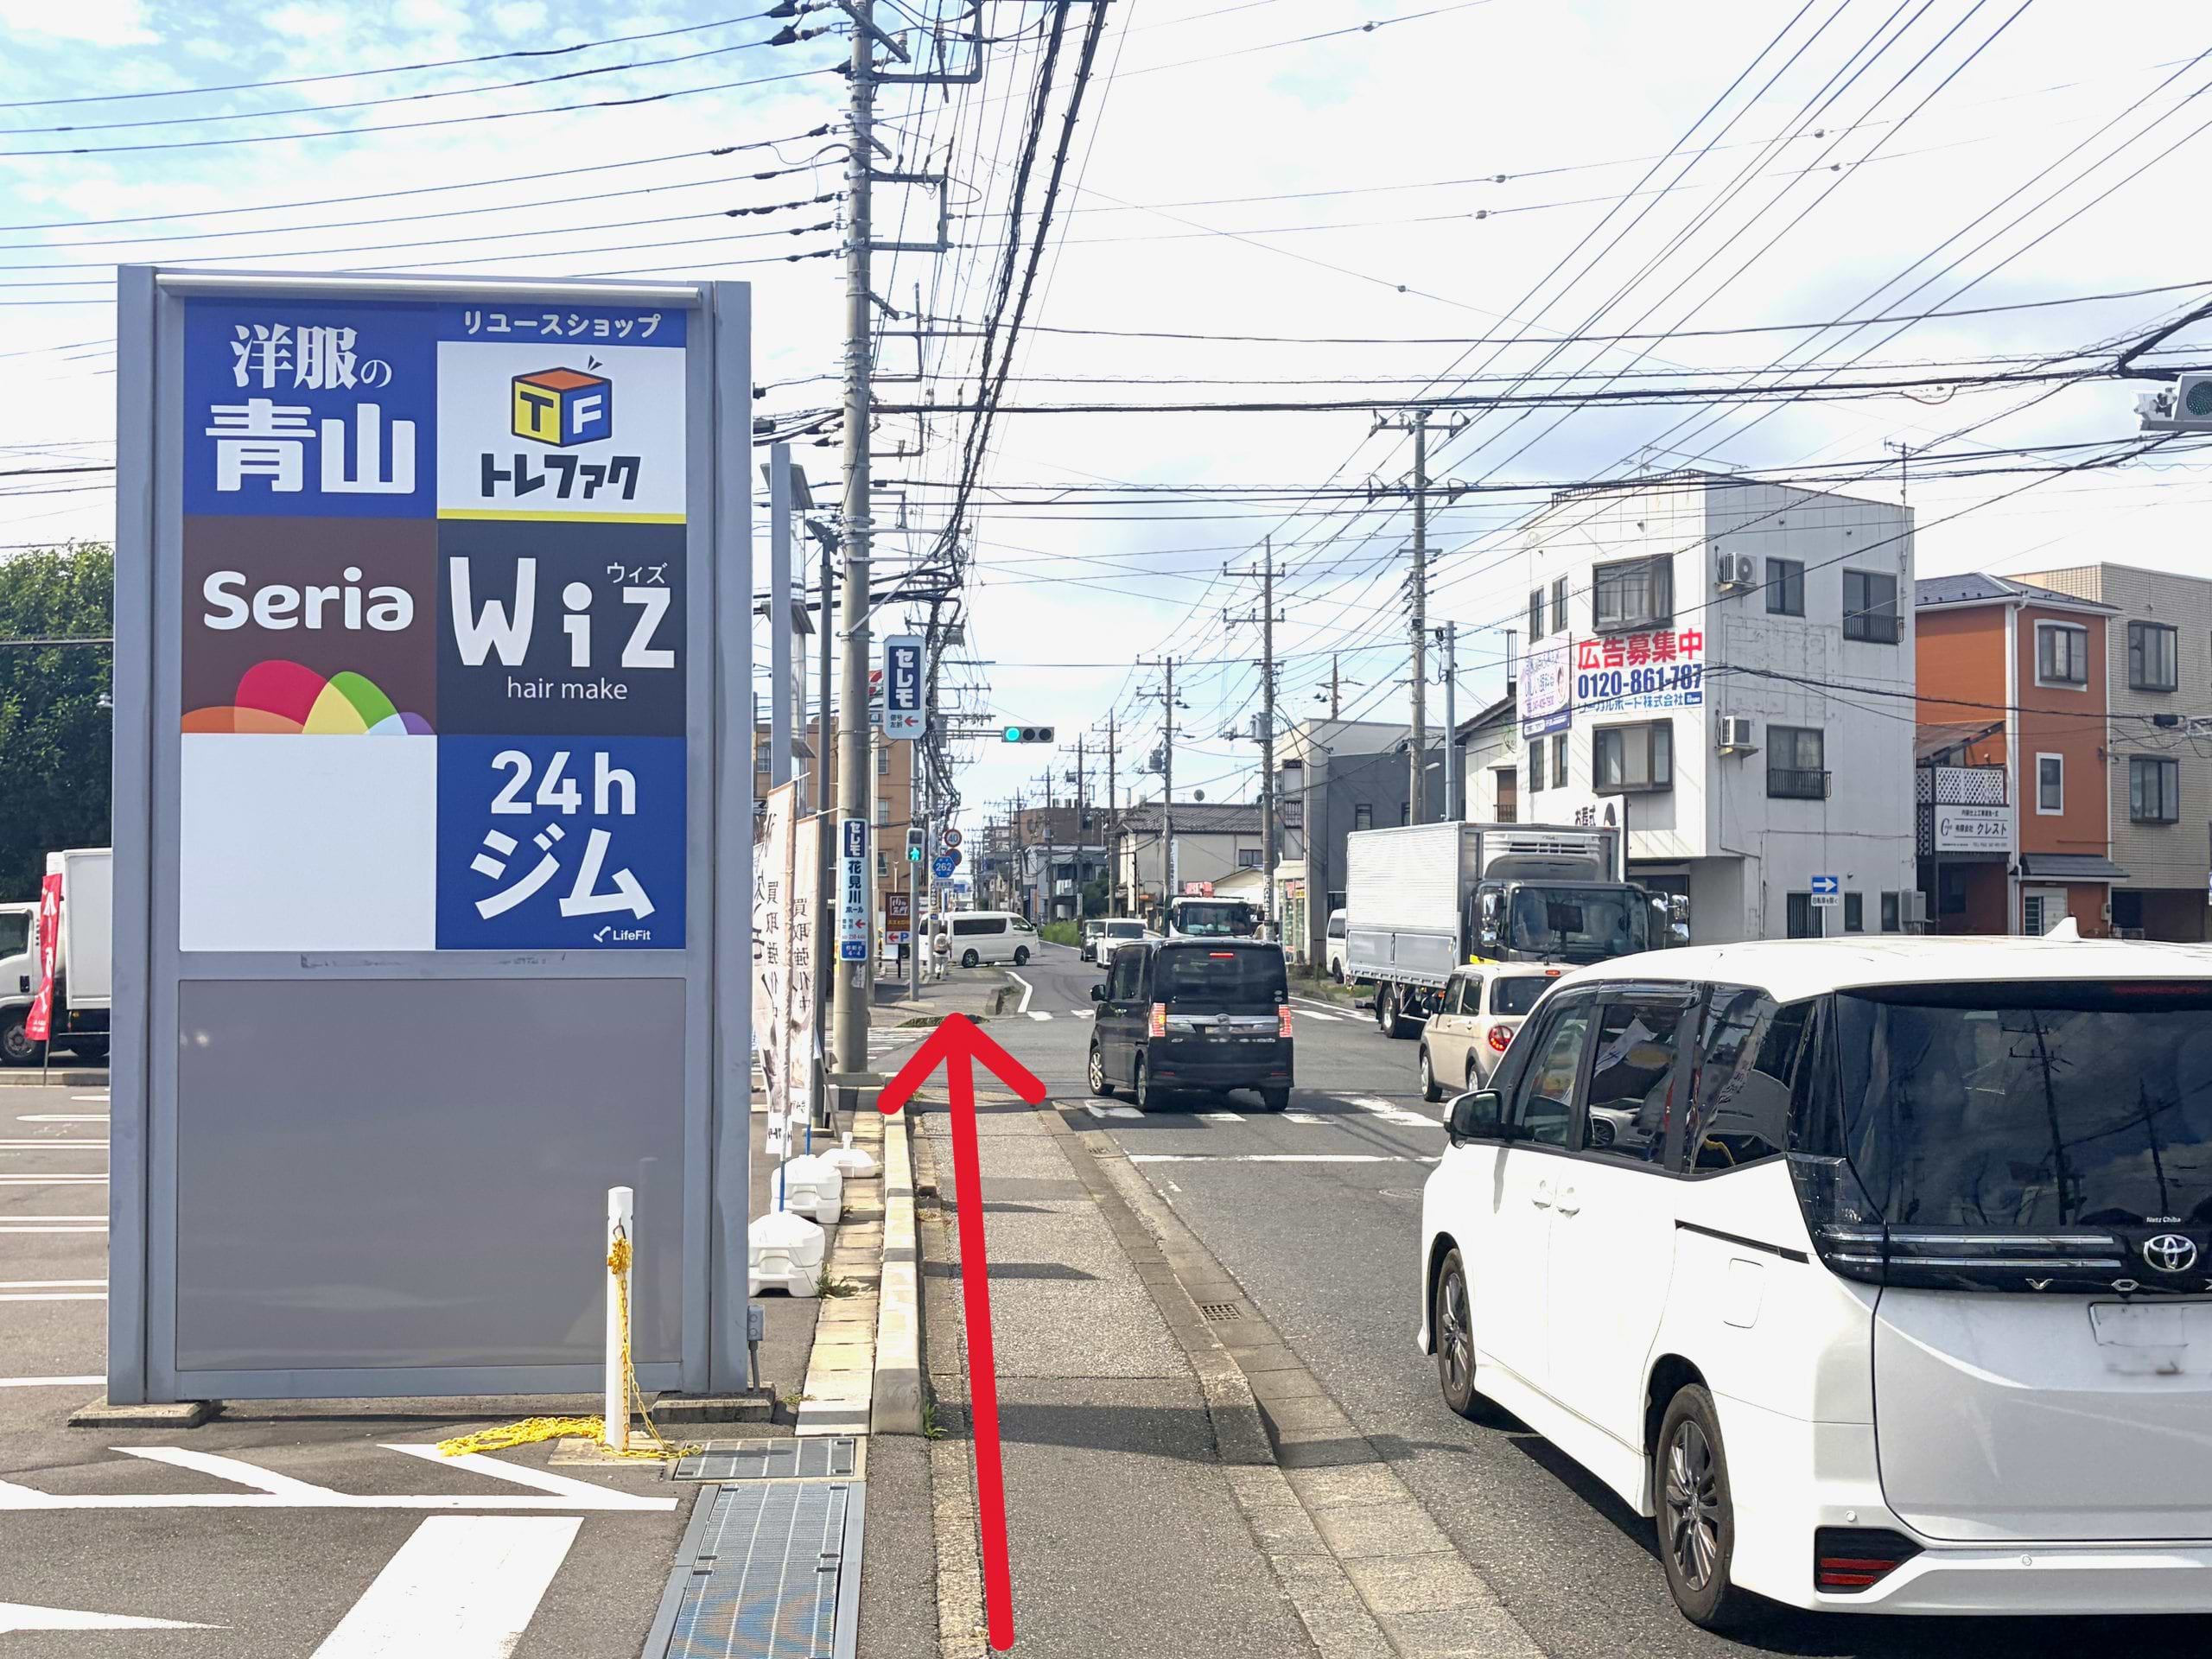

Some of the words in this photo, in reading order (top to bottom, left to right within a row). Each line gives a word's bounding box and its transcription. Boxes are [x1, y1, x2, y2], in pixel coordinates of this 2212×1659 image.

[464, 310, 661, 339] リユースショップ
[230, 323, 392, 391] 洋服の
[205, 397, 416, 495] 青山
[481, 454, 642, 500] トレファク
[607, 563, 668, 585] ウィズ
[202, 566, 415, 632] Seria
[1578, 628, 1703, 671] 広告募集中
[507, 677, 554, 698] hair
[561, 677, 628, 700] make
[895, 648, 914, 708] セレモ
[1578, 663, 1703, 700] 0120-861-787
[491, 749, 636, 815] 24h
[849, 821, 861, 856] セレモ
[949, 834, 958, 842] 40
[1977, 823, 2007, 836] クレスト
[470, 822, 656, 920] ジム
[849, 860, 862, 904] 花見川
[936, 863, 952, 872] 262
[613, 930, 652, 941] LifeFit
[900, 932, 909, 942] P
[2025, 1278, 2212, 1292] VO
